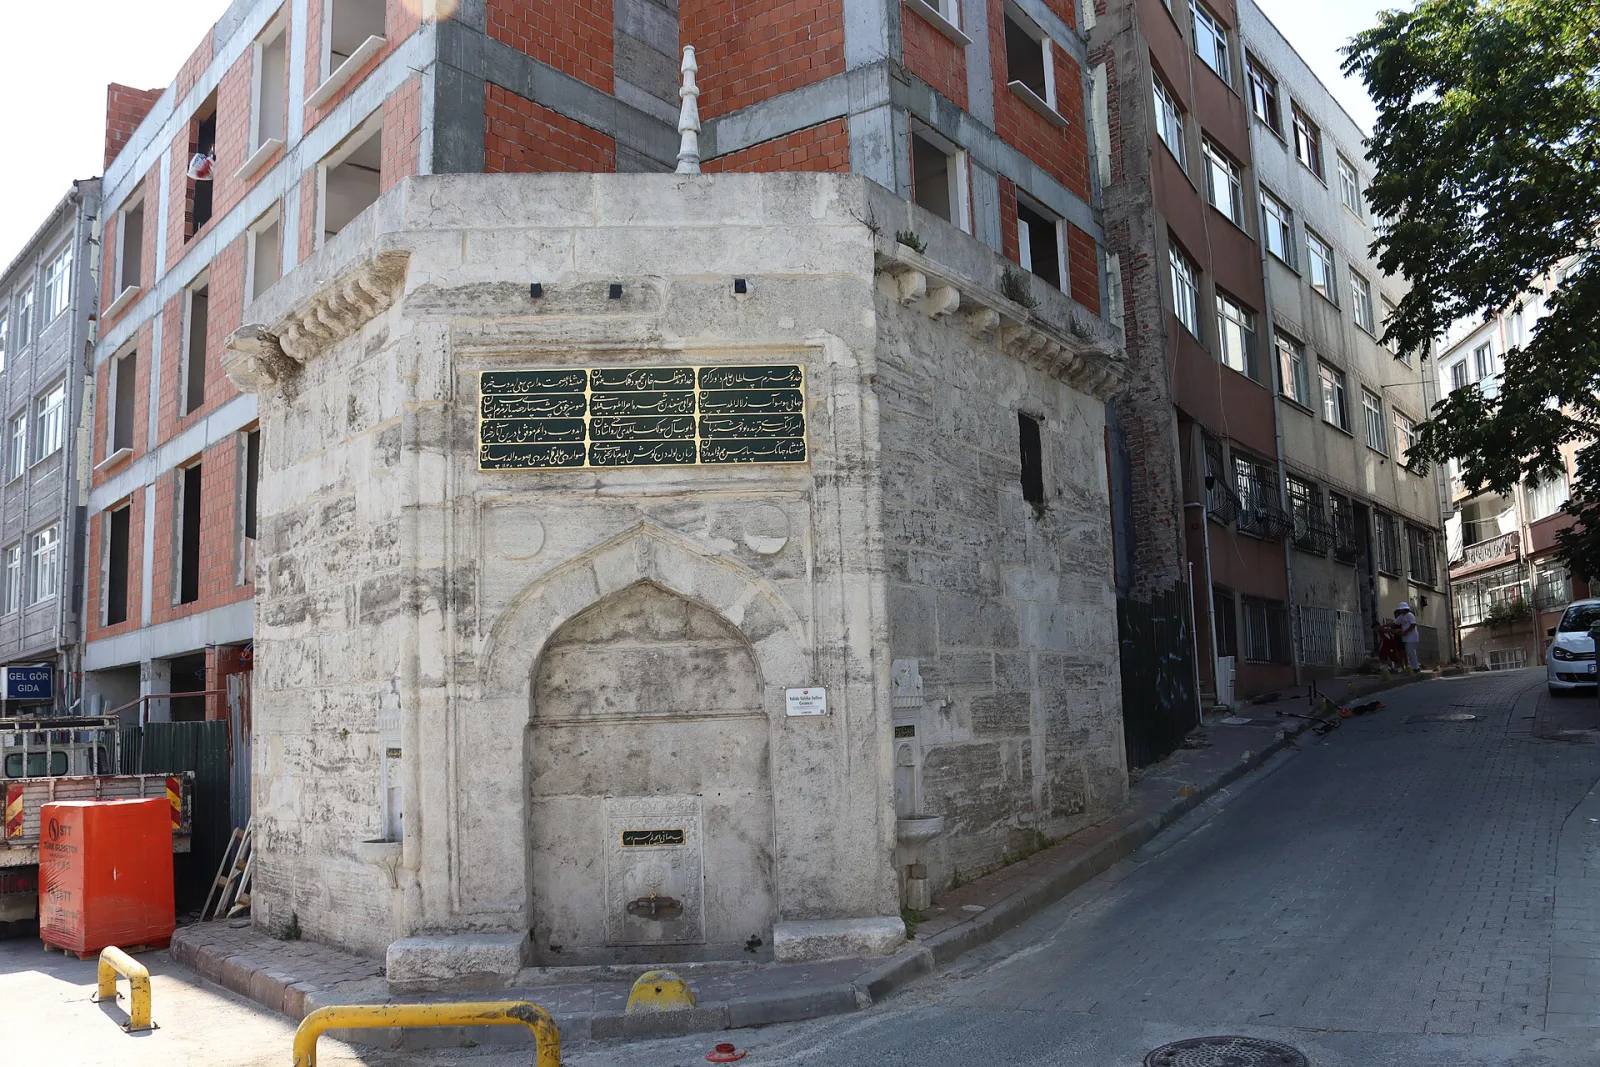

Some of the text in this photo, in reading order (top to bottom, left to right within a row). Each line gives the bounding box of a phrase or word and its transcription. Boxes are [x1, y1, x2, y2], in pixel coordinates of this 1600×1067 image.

[8, 672, 48, 680] GEL GÖR
[60, 825, 72, 836] STT
